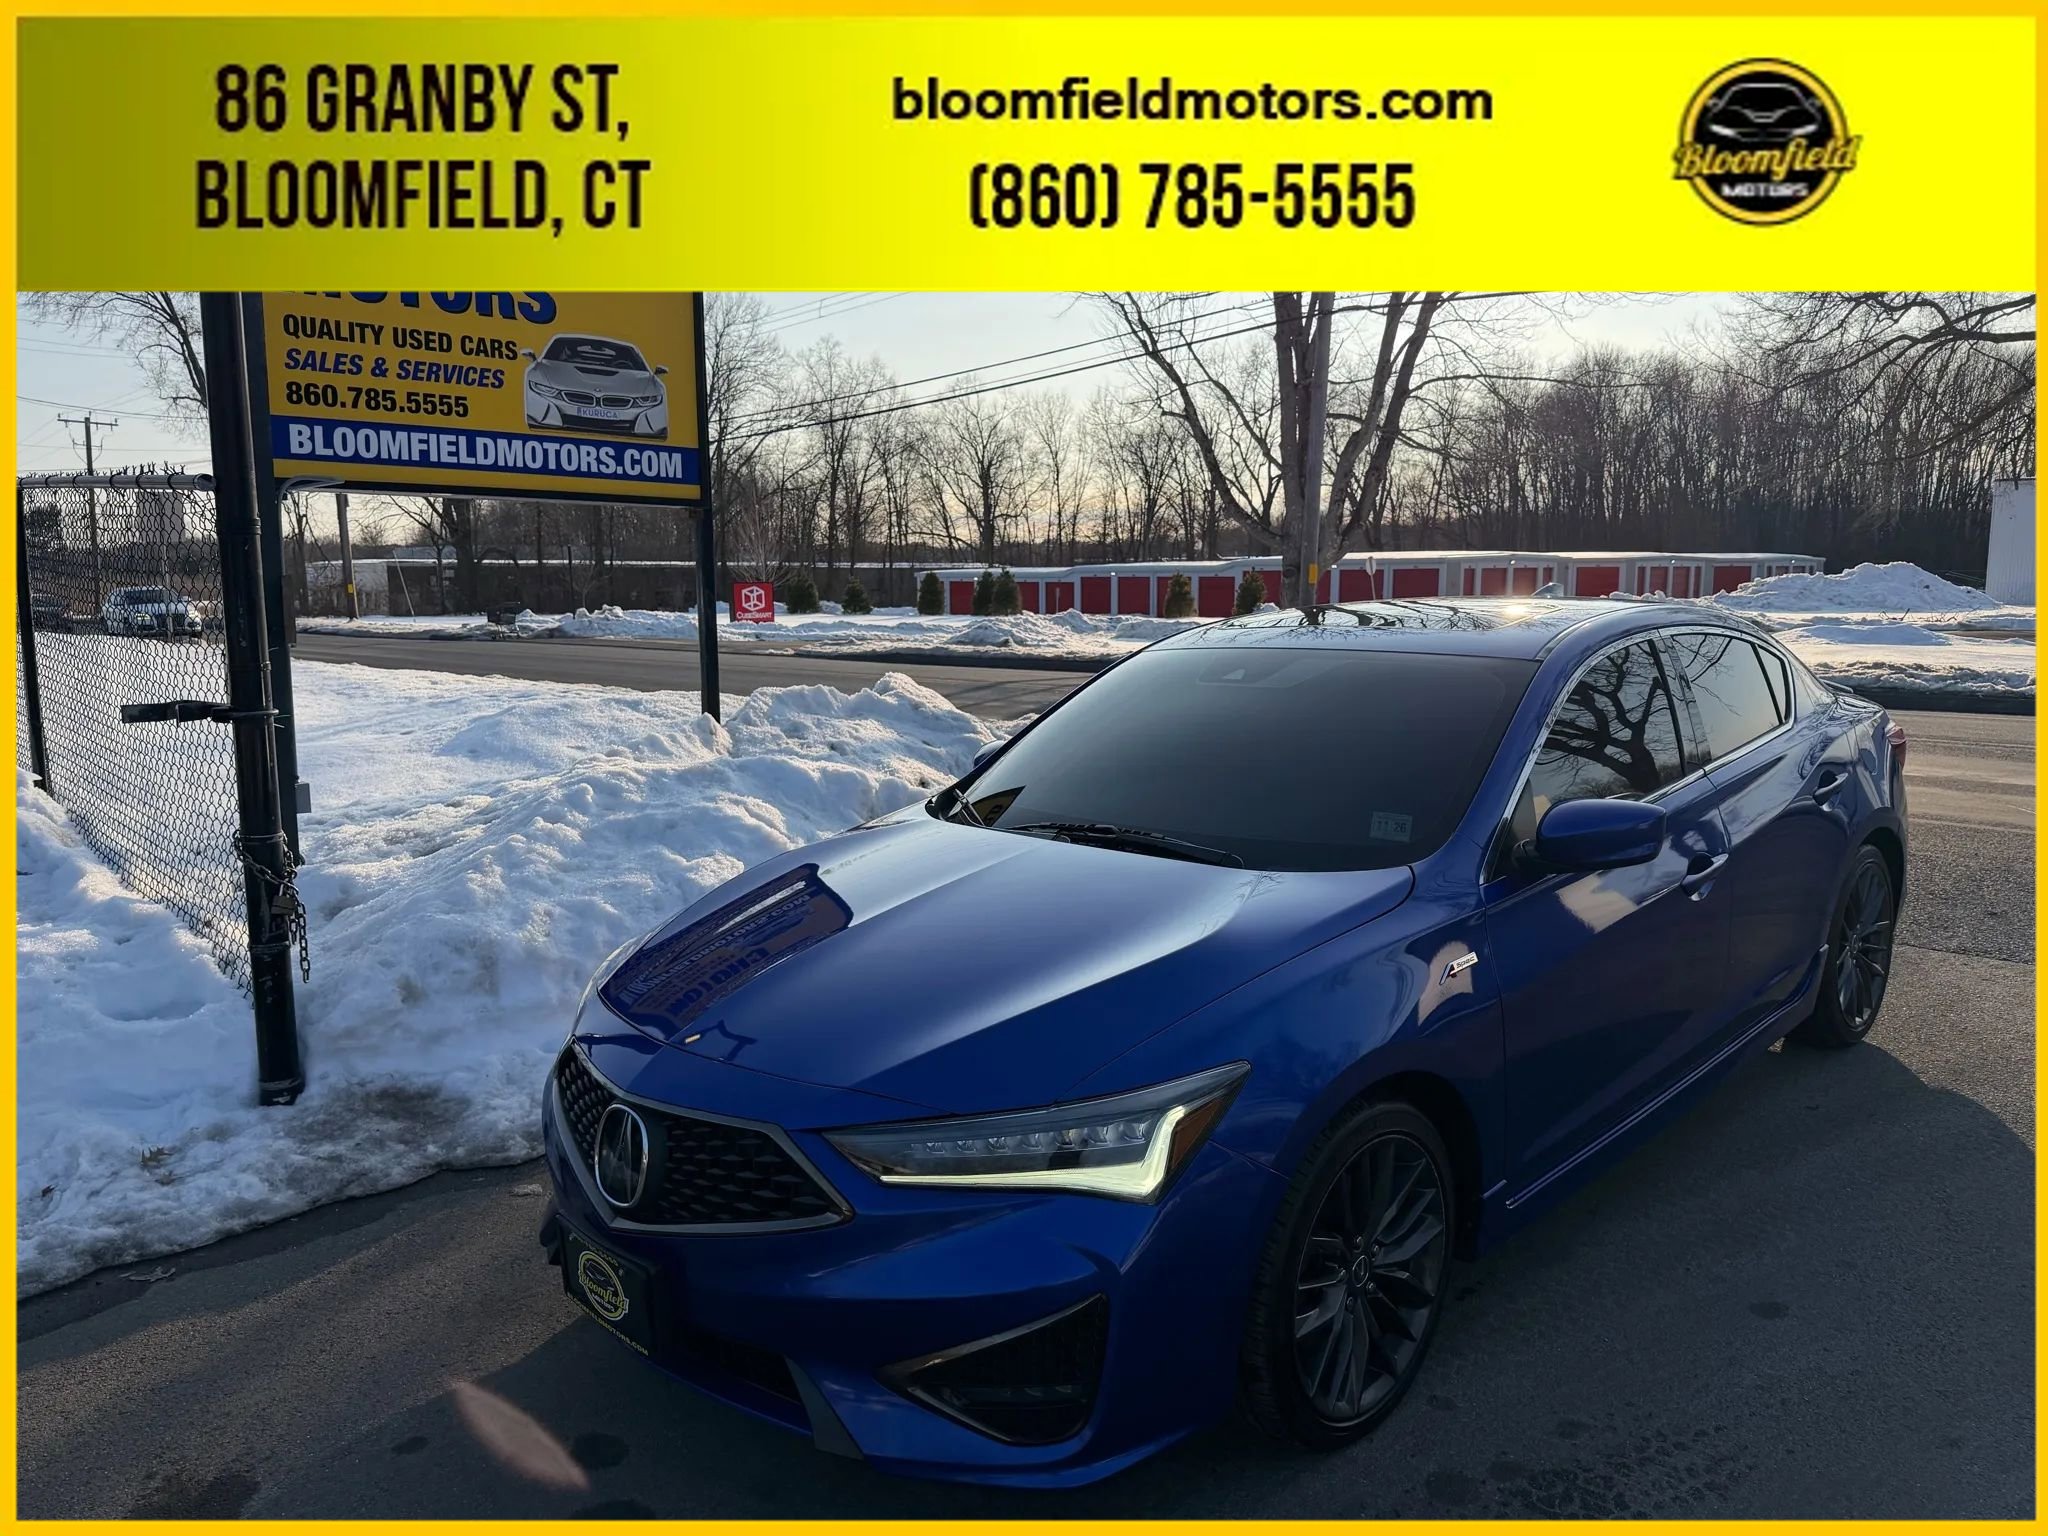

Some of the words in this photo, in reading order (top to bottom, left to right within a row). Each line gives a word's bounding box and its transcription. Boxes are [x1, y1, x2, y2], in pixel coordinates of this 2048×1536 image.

[283, 314, 384, 345] QUALITY
[392, 327, 453, 353] USED
[460, 335, 518, 360] CARS
[285, 348, 364, 375] SALES
[370, 357, 389, 377] &
[396, 359, 505, 389] SERVICES
[286, 381, 469, 417] 860.785.5555
[289, 424, 682, 479] BLOOMFIELDMOTORS.COM
